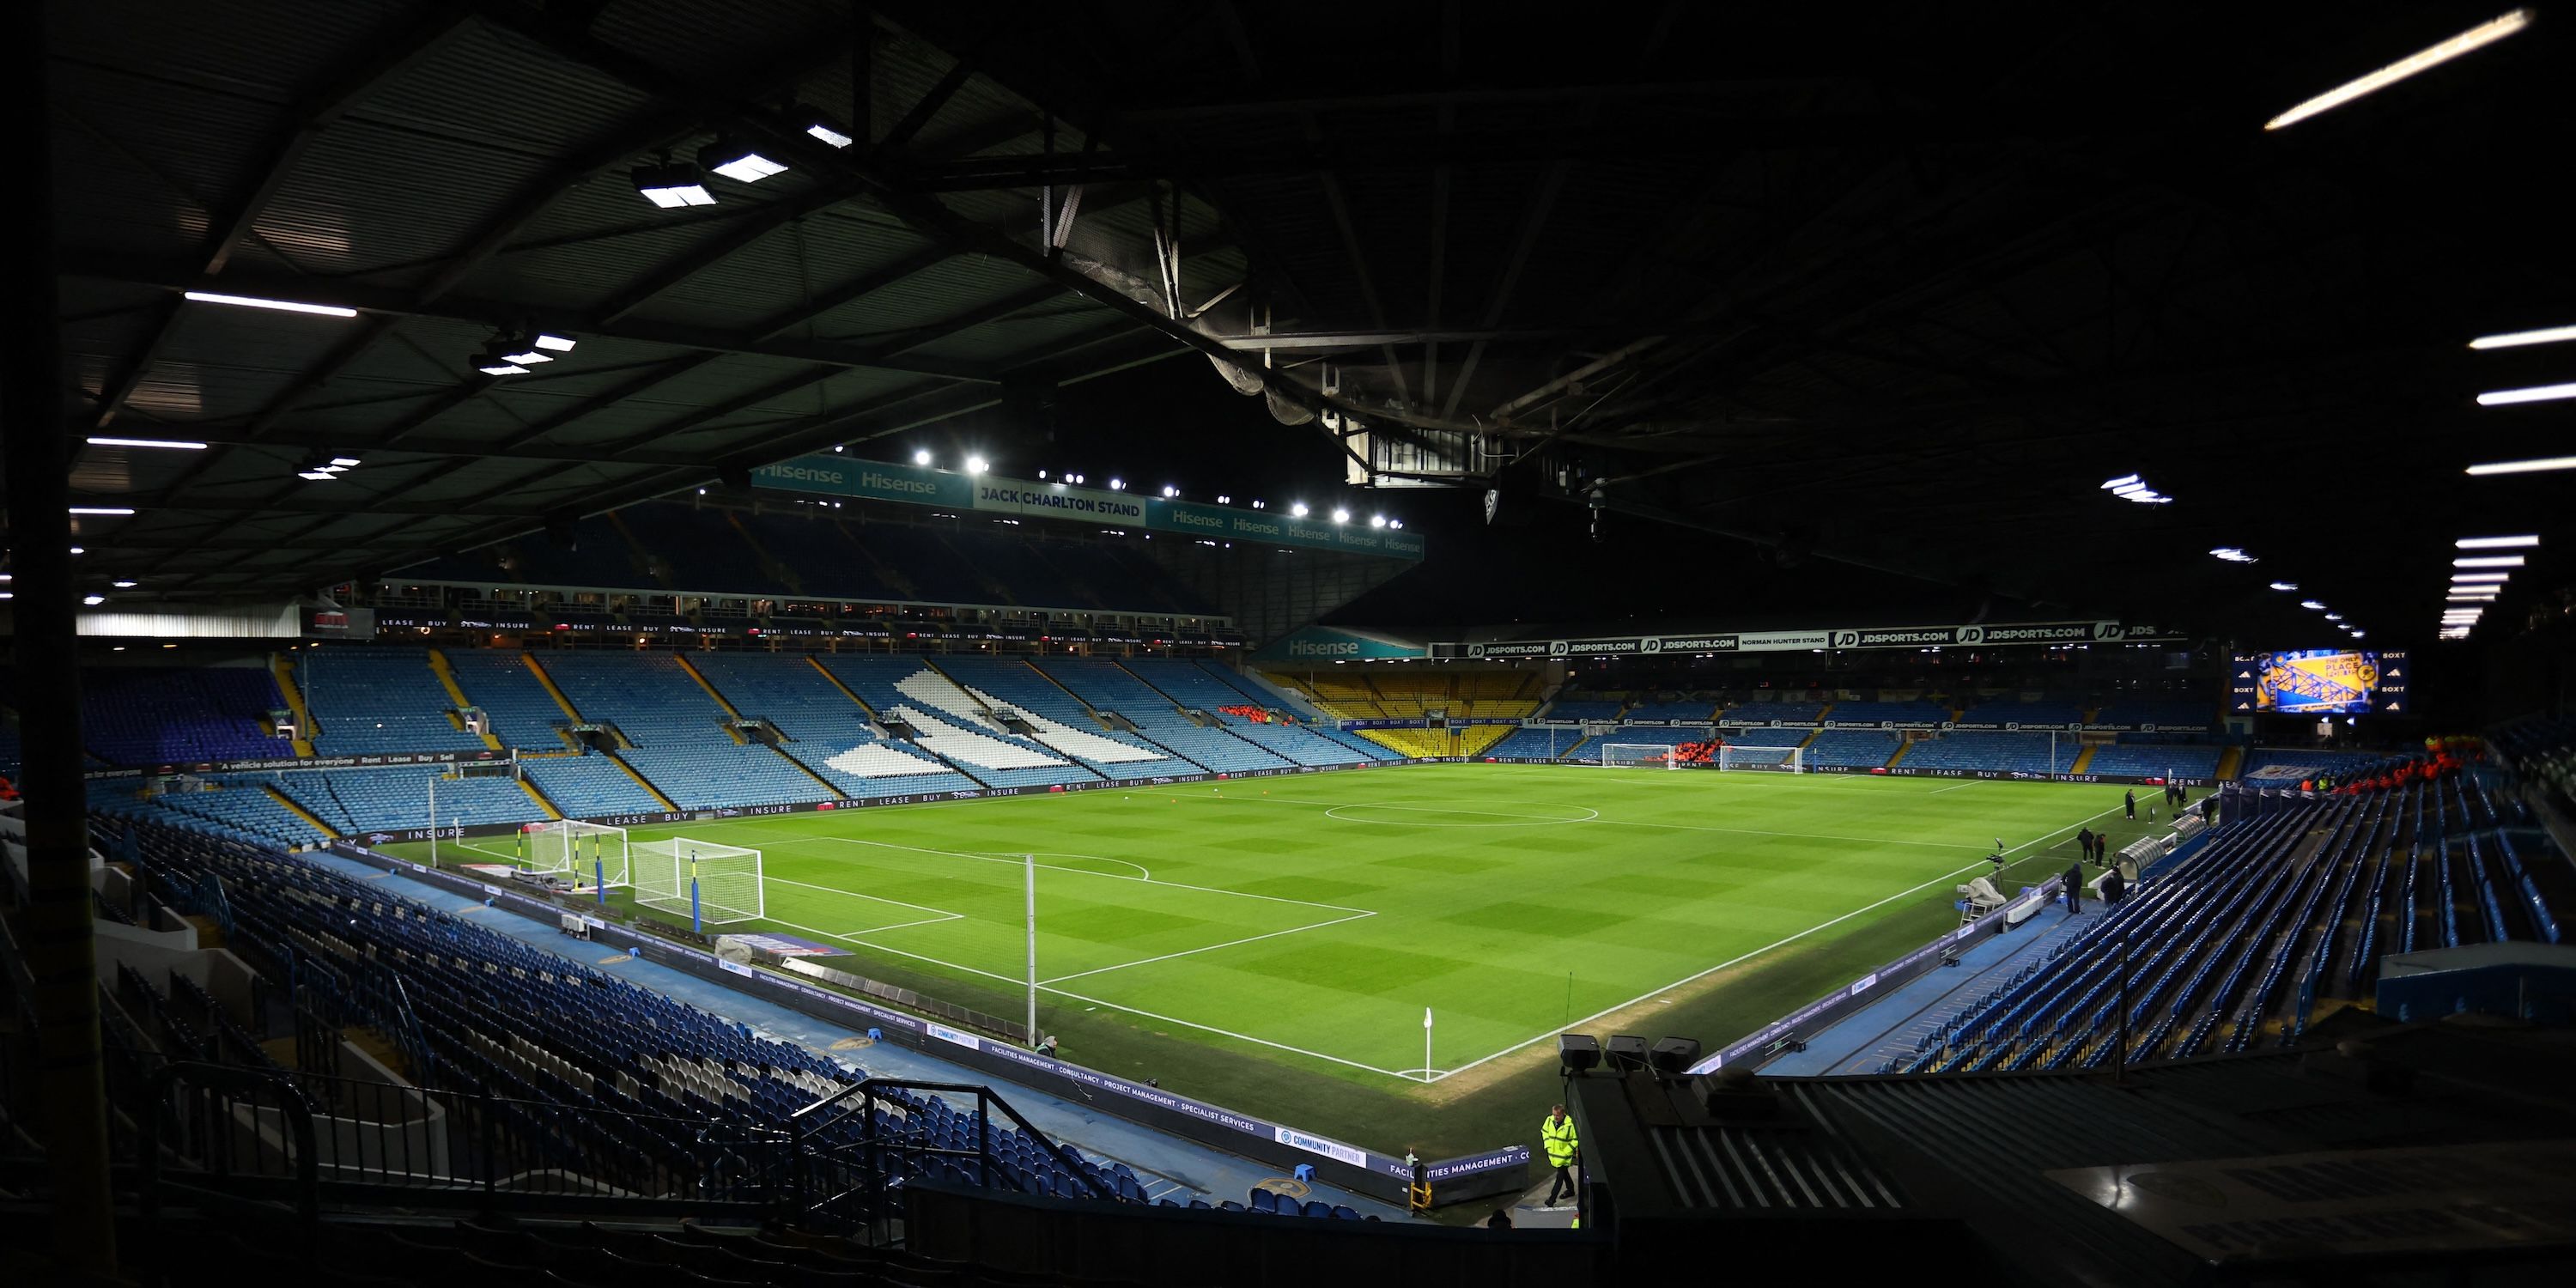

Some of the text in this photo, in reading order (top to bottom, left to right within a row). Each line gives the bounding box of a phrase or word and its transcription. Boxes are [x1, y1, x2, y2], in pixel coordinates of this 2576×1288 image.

[861, 471, 937, 494] Hisense
[981, 487, 1139, 517] JACK CHARLTON STAND
[1173, 510, 1421, 553] Hisense Hisense Hisense Hisense Hisense
[1862, 632, 1949, 644] JDSPORTS.COM
[1987, 628, 2086, 640] JDSPORTS.COM
[1289, 640, 1358, 656] Hisense
[1485, 644, 1546, 655] JDSPORTS.COM
[1571, 642, 1636, 653] JDSPORTS.COM
[1662, 639, 1735, 650] JDSPORTS.COM
[2326, 662, 2359, 671] PLACE
[231, 761, 262, 770] vehicle
[263, 759, 299, 769] solution
[300, 758, 313, 767] for
[314, 757, 355, 767] everyone
[418, 754, 434, 762] Buy
[440, 753, 454, 762] Sell
[2055, 774, 2099, 782] INSURE
[839, 799, 866, 809] RENT
[879, 796, 909, 805] LEASE
[922, 793, 941, 802] BUY
[987, 787, 1019, 797] INSURE
[606, 805, 792, 826] LEASE BUY INSURE
[776, 978, 799, 990] MANAGEMENT
[800, 987, 826, 999] CONSULTANCY
[828, 995, 844, 1005] PROJECT
[845, 999, 871, 1013] MANAGEMENT
[873, 1010, 896, 1021] SPECIALIST
[896, 1016, 916, 1028] SERVICES
[1729, 1044, 1747, 1058] FACILITIES
[991, 1046, 1255, 1132] FACILITIES MANAGEMENT CONSULTANCY PROJECT MANAGEMENT SPECIALIST SERVICES
[1293, 1134, 1360, 1163] COMMUNITY PARTNER
[1451, 1154, 1512, 1174] MANAGEMENT
